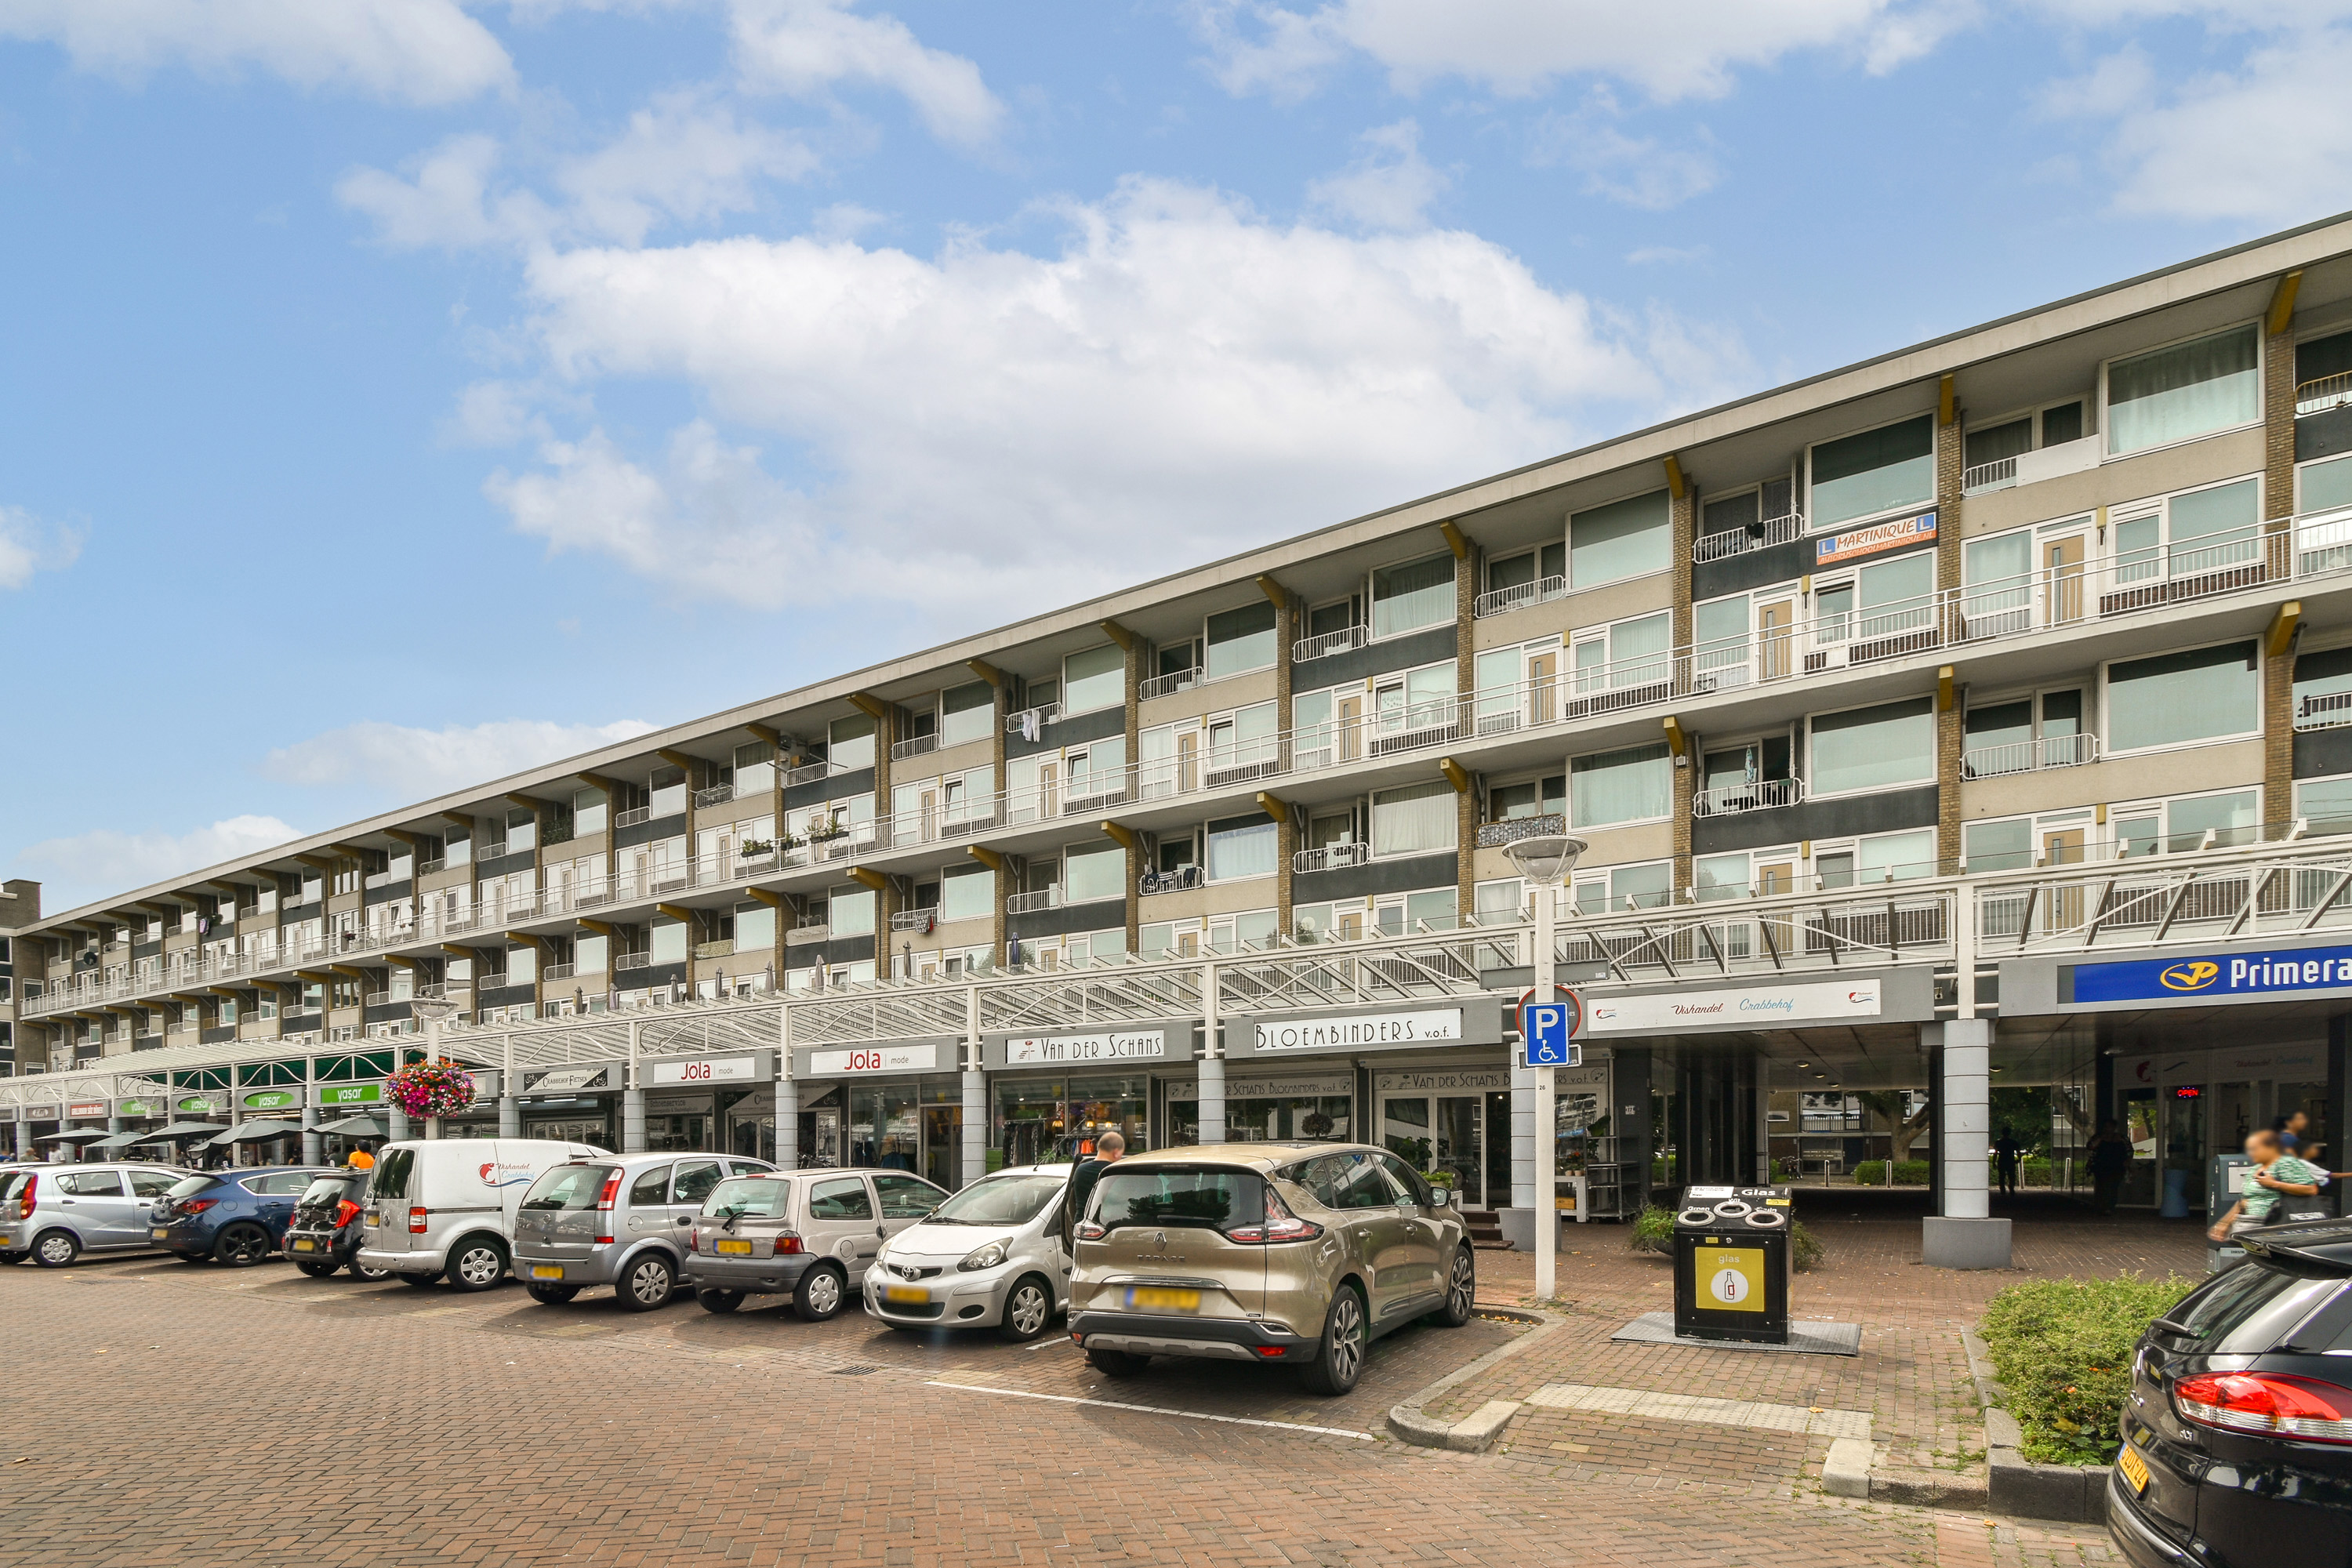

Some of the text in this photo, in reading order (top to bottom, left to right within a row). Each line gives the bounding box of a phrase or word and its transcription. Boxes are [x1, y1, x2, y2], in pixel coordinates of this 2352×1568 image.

[1822, 518, 1931, 554] L MARTINIQUE L
[2230, 956, 2352, 988] Primera
[1671, 997, 1794, 1015] Vishandel Crabbehof
[1535, 1008, 1559, 1040] P
[1255, 1020, 1450, 1049] BLOEMBINDERS v.o.f.
[844, 1050, 909, 1070] Jola mode
[681, 1062, 734, 1080] Jola mode
[259, 1095, 281, 1108] yaşar
[337, 1087, 362, 1103] yaşar
[1718, 1254, 1740, 1265] glas
